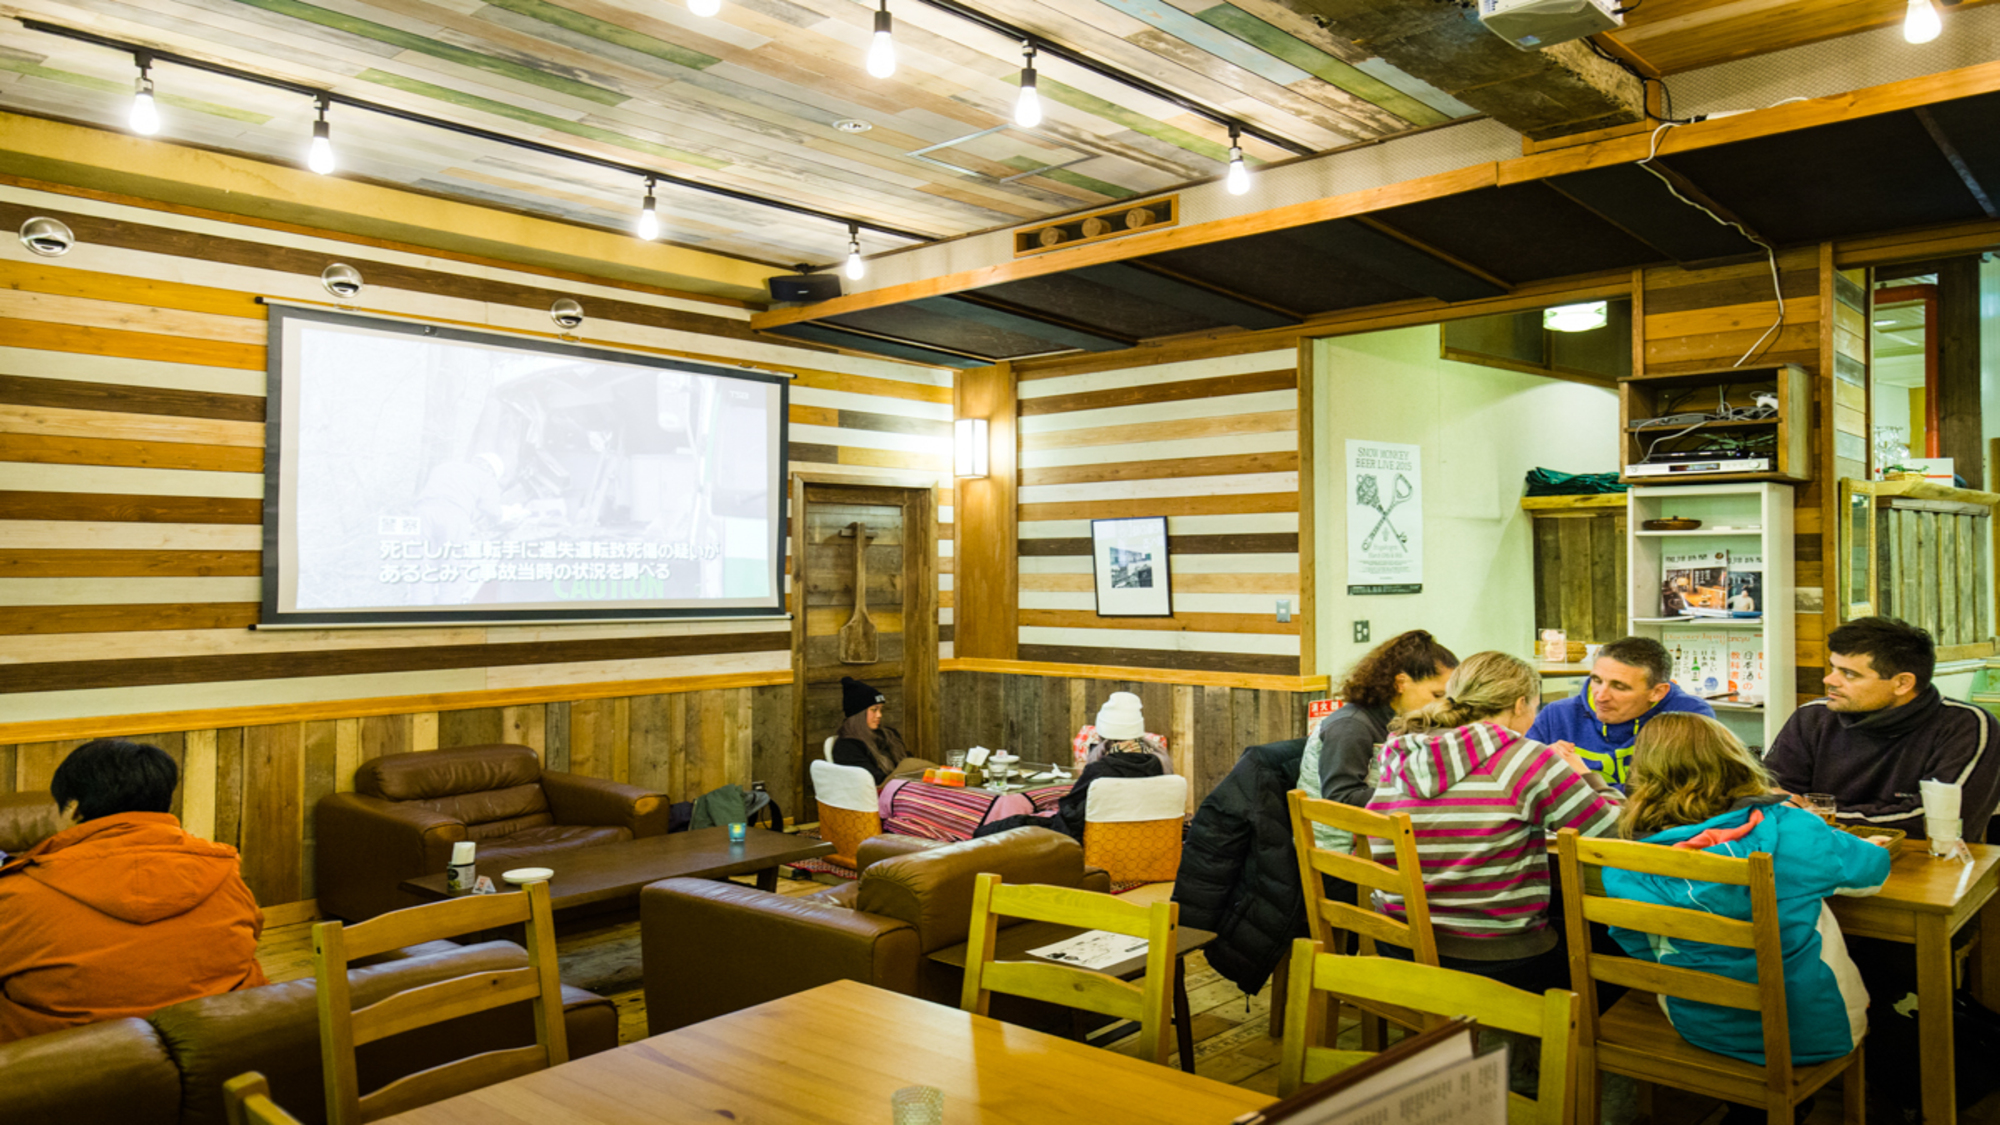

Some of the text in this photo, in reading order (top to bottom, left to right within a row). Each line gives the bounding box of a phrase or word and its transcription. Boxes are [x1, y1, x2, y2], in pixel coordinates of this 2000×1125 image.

[1357, 447, 1409, 460] SNOW MONKEY
[1356, 458, 1412, 471] BEER LIVE 2015
[379, 562, 672, 583] あるとみて事故当時の状況を調べる
[552, 577, 665, 600] CAUTION
